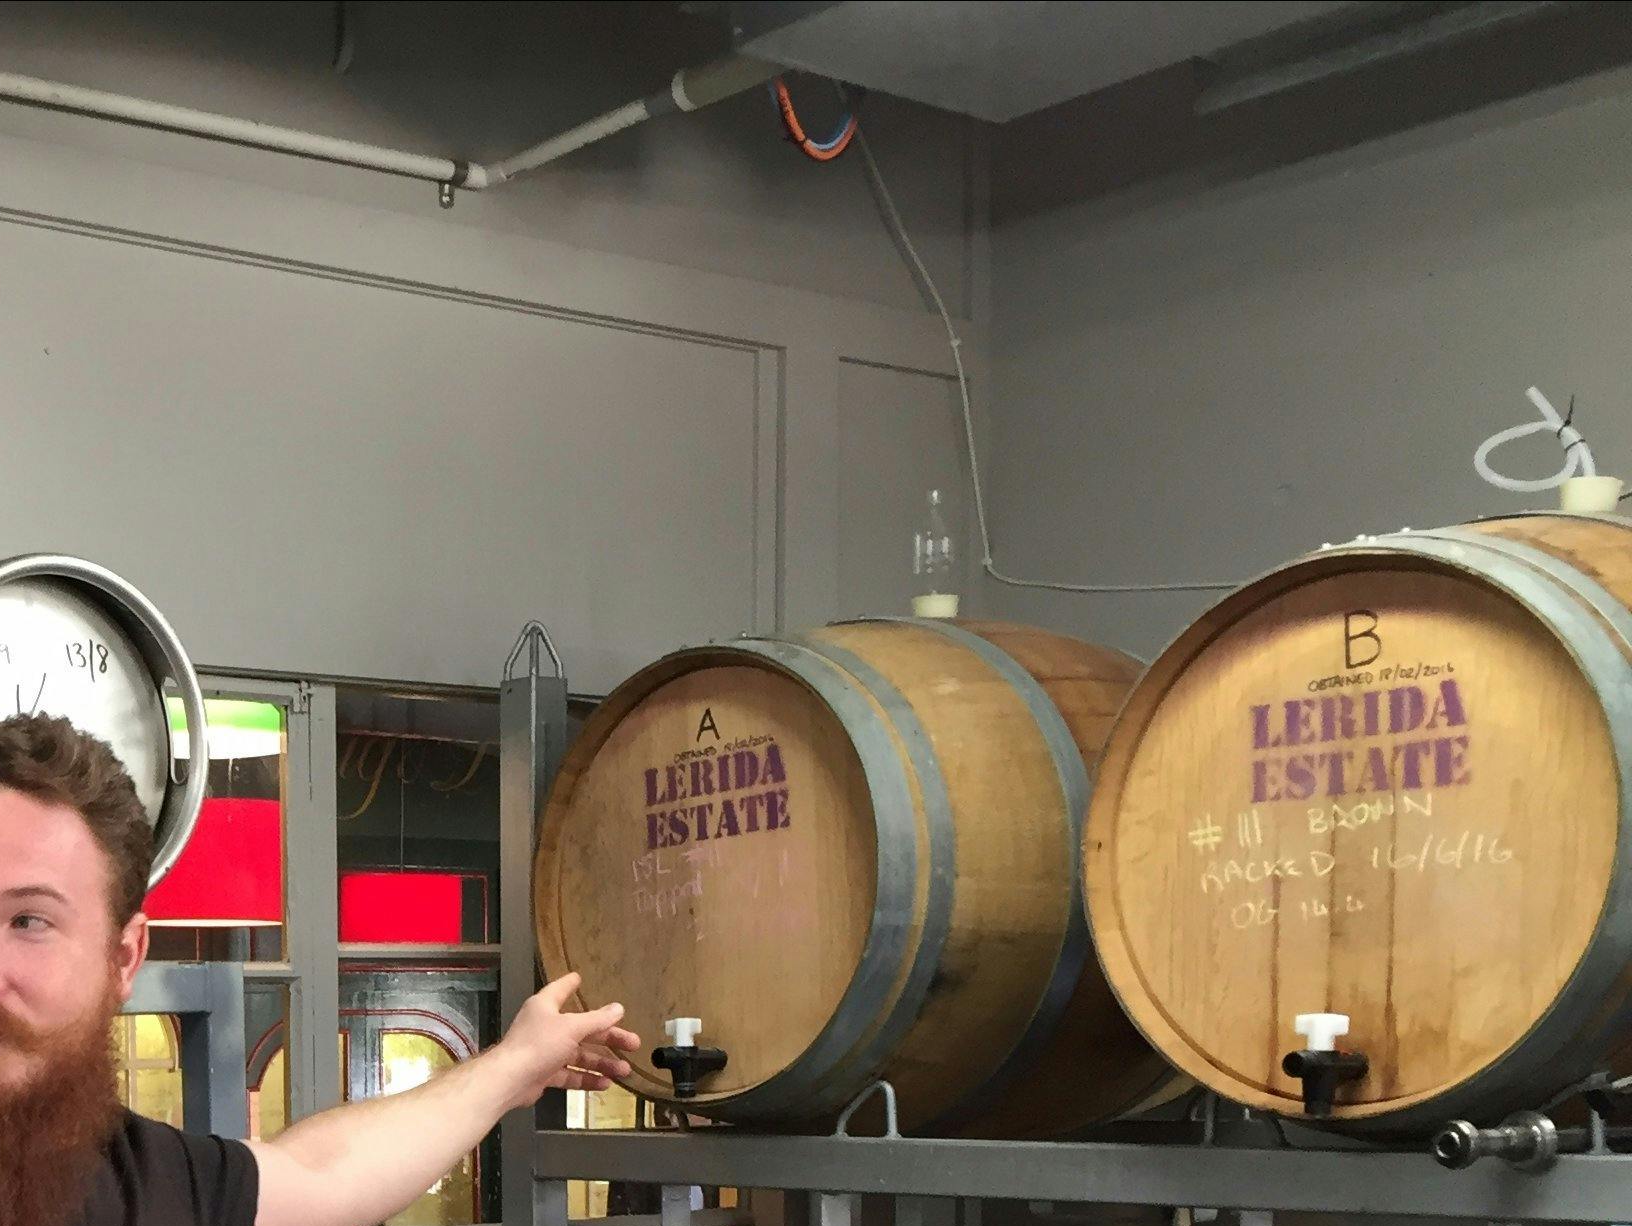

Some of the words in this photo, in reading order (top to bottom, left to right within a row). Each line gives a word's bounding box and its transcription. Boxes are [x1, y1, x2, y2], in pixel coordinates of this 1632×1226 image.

[64, 638, 110, 684] 13/8
[1344, 609, 1382, 670] B
[696, 707, 721, 743] A
[1248, 678, 1468, 750] LERIDA
[643, 743, 787, 807] LERIDA
[1250, 735, 1472, 804] ESTATE
[645, 788, 791, 850] ESTATE
